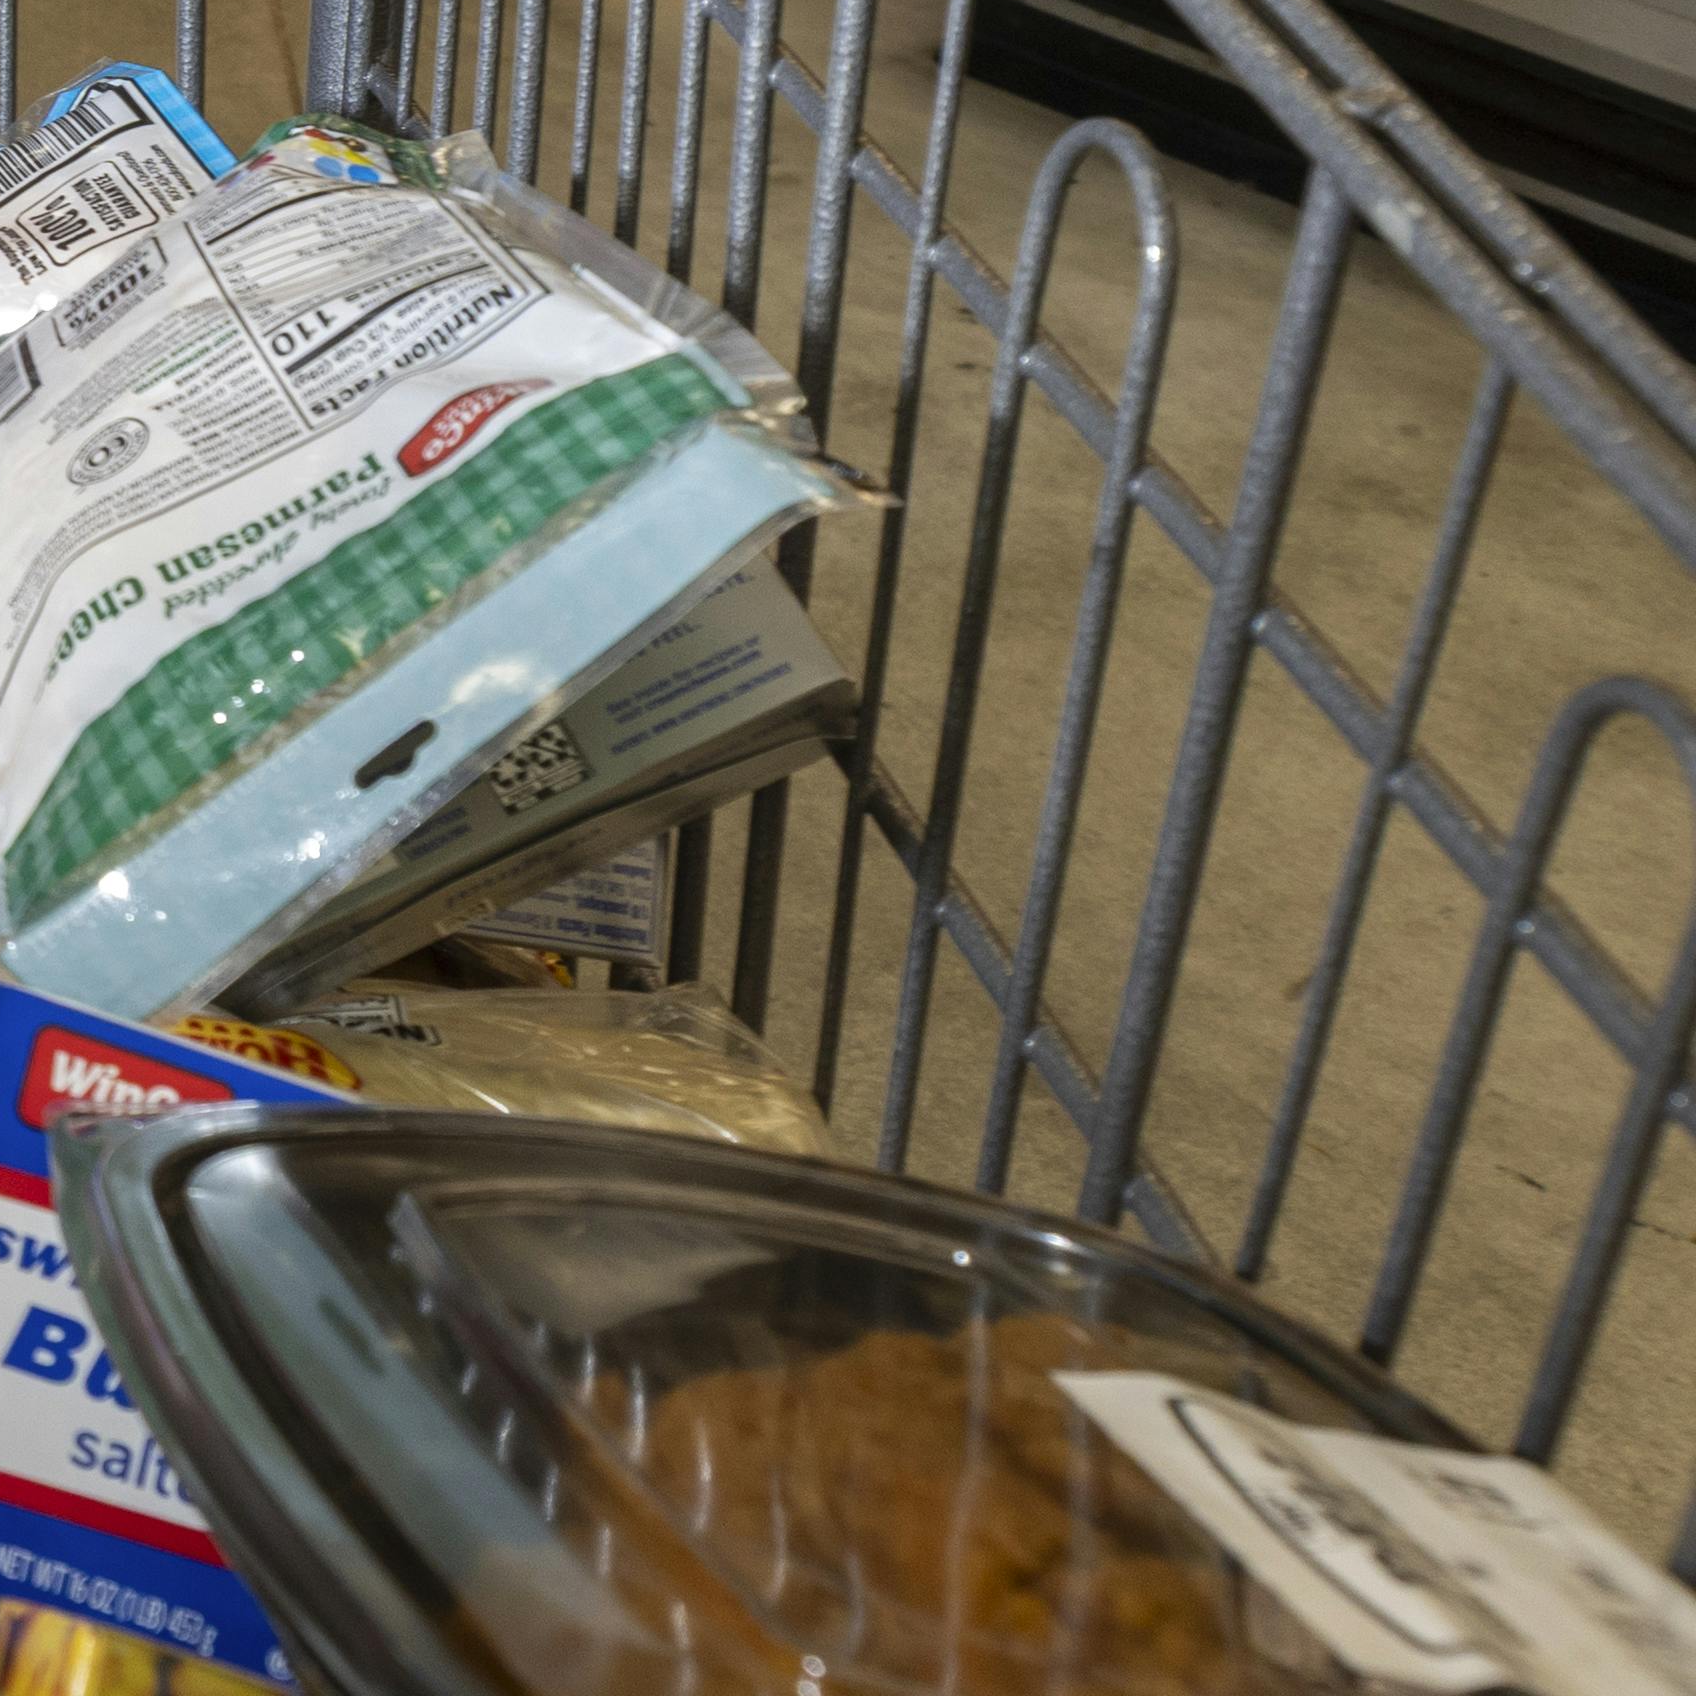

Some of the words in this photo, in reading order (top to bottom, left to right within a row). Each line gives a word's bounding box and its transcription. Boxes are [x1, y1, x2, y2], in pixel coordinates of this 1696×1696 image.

[27, 192, 97, 255] 100%
[71, 176, 126, 233] SATISFACTION
[93, 171, 141, 220] GUARANTEE
[268, 302, 340, 360] 110
[392, 279, 511, 373] Nutrition
[311, 364, 385, 423] Facts
[151, 455, 385, 581] Parmesan
[155, 522, 307, 628] shredded
[31, 1553, 68, 1591] WT
[67, 1562, 90, 1600] 16
[88, 1569, 117, 1609] OZ
[116, 1579, 139, 1622] (1
[137, 1588, 170, 1635] LB)
